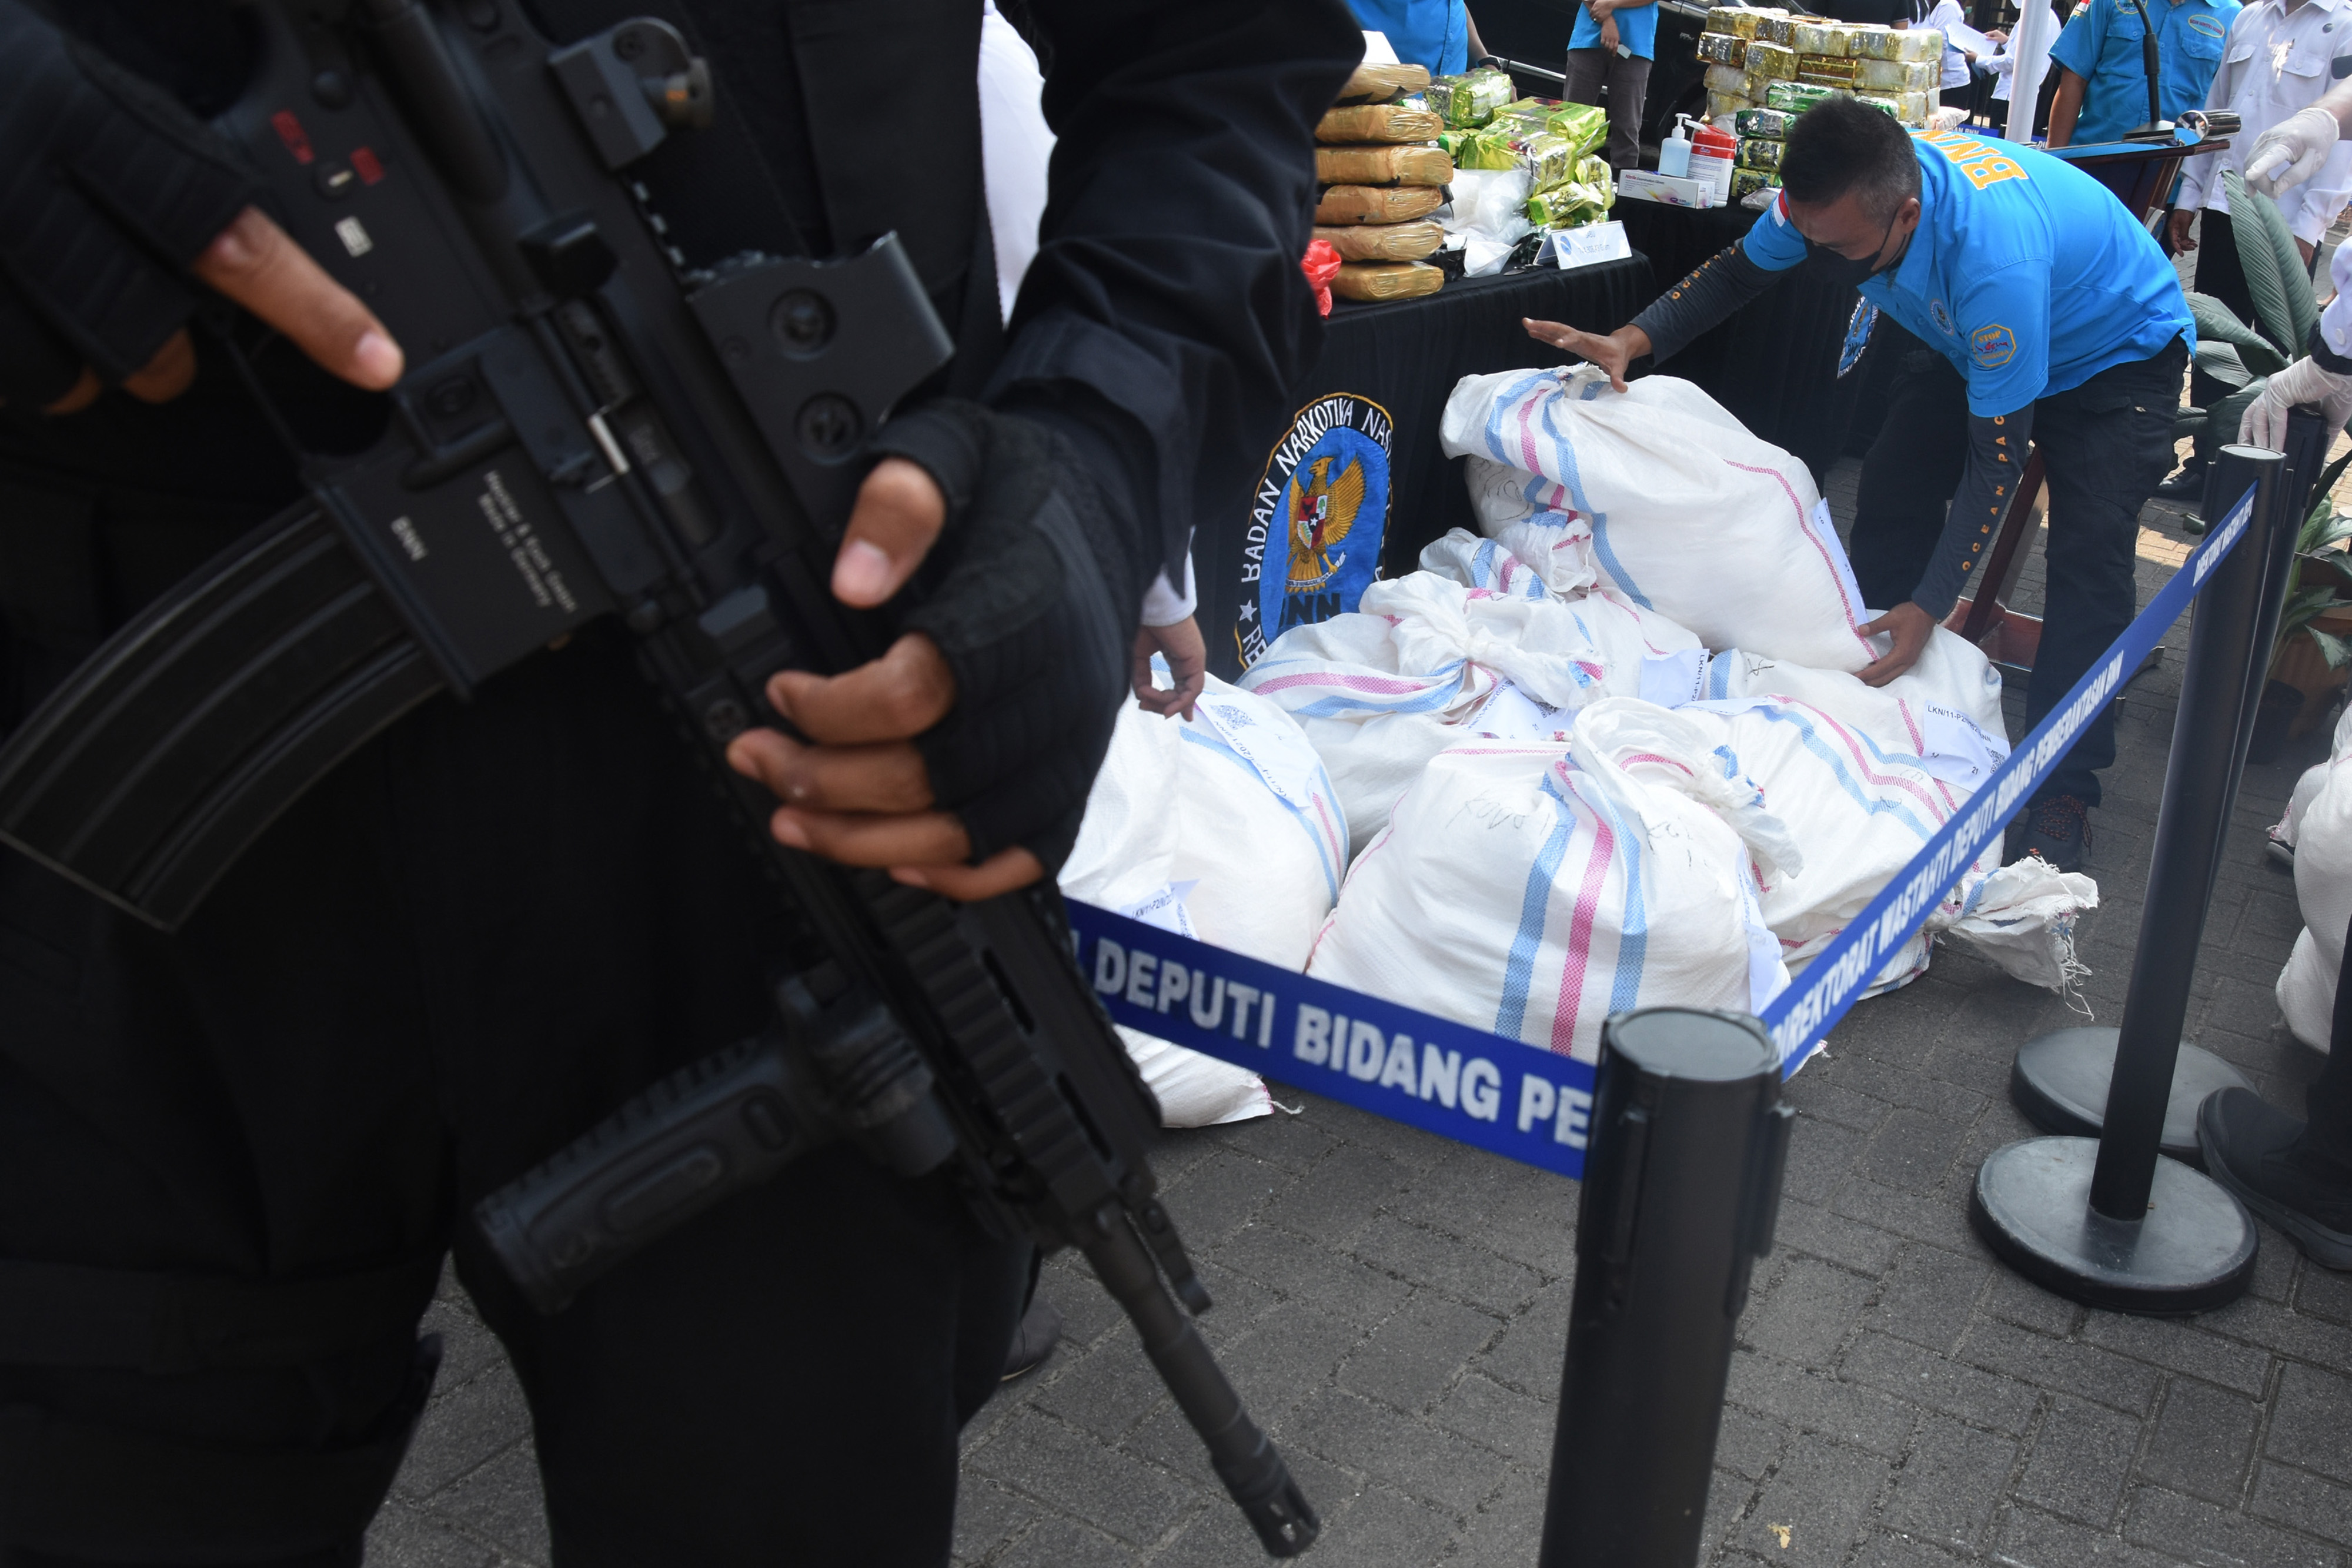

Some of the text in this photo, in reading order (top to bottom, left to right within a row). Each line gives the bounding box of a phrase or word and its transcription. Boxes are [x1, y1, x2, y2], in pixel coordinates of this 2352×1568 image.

[1909, 130, 2029, 190] BNN
[1979, 330, 2001, 343] STOP
[1241, 478, 1281, 583] BADAN
[1278, 593, 1341, 628] NN
[1972, 766, 1979, 775] 21
[1772, 918, 1880, 1066] DIREKTORAT
[1878, 838, 1952, 956] WASTAHTI
[1949, 788, 1997, 874] DEPUTI
[1994, 747, 2036, 823] BIDANG
[1094, 937, 1592, 1151] DEPUTI BIDANG PE
